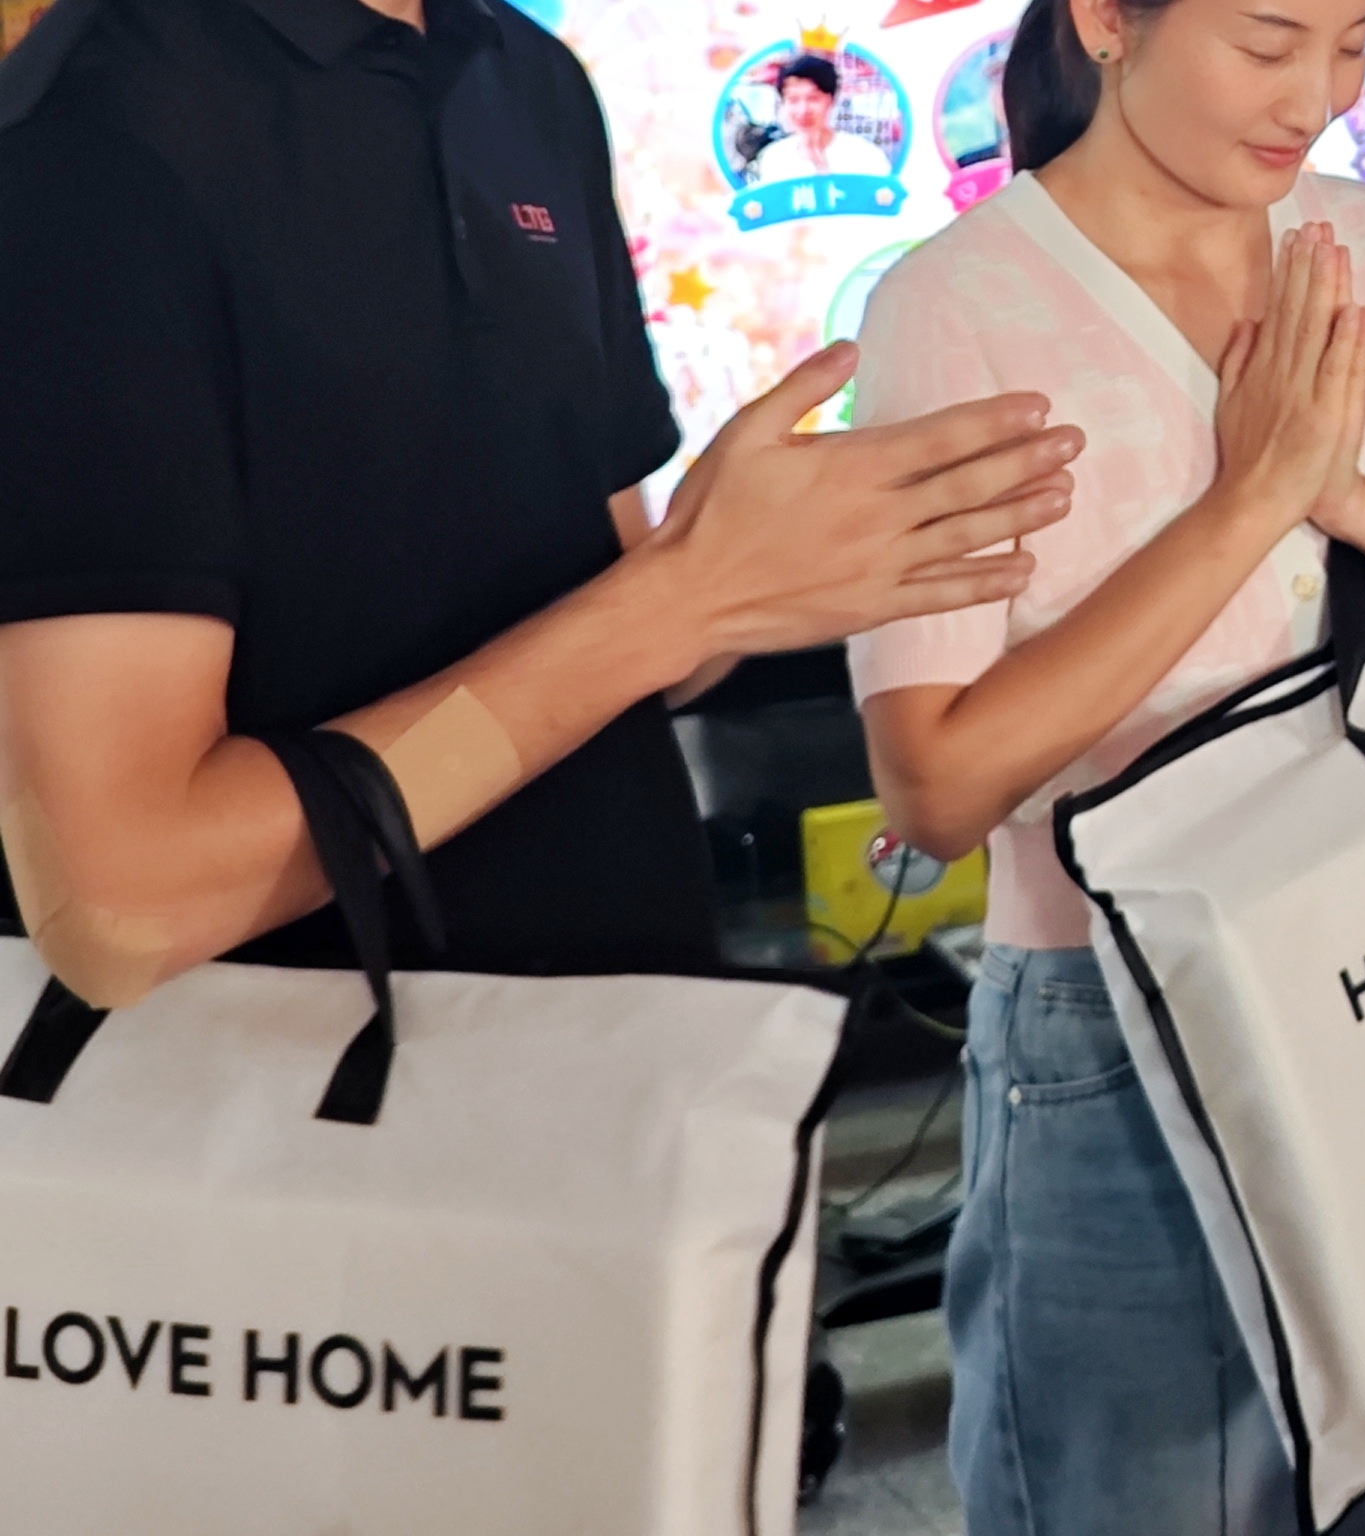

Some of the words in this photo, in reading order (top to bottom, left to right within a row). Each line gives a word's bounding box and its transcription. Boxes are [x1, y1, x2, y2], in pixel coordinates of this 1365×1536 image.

[509, 202, 556, 233] LTG
[4, 1305, 212, 1398] LOVE
[243, 1328, 505, 1422] HOME
